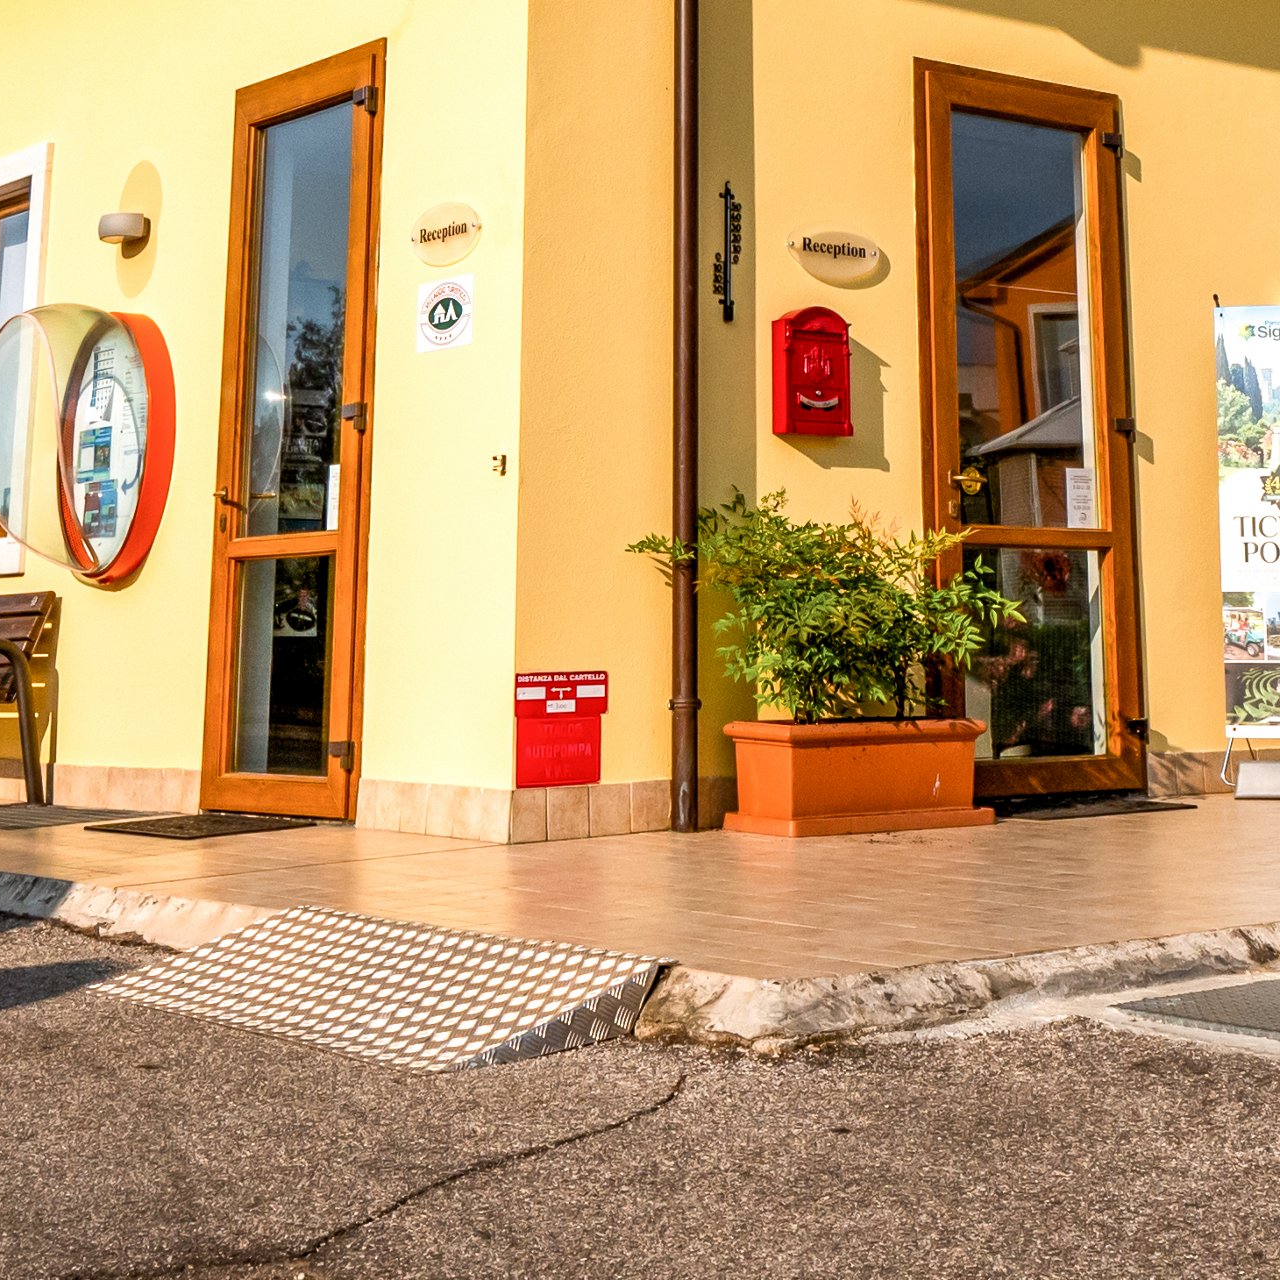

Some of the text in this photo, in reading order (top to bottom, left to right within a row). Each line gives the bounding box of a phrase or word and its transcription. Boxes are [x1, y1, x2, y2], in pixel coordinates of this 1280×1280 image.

[419, 221, 468, 244] Reception
[802, 237, 867, 259] Reception
[517, 675, 553, 683] DISTANZA
[569, 673, 606, 681] CARTELLO
